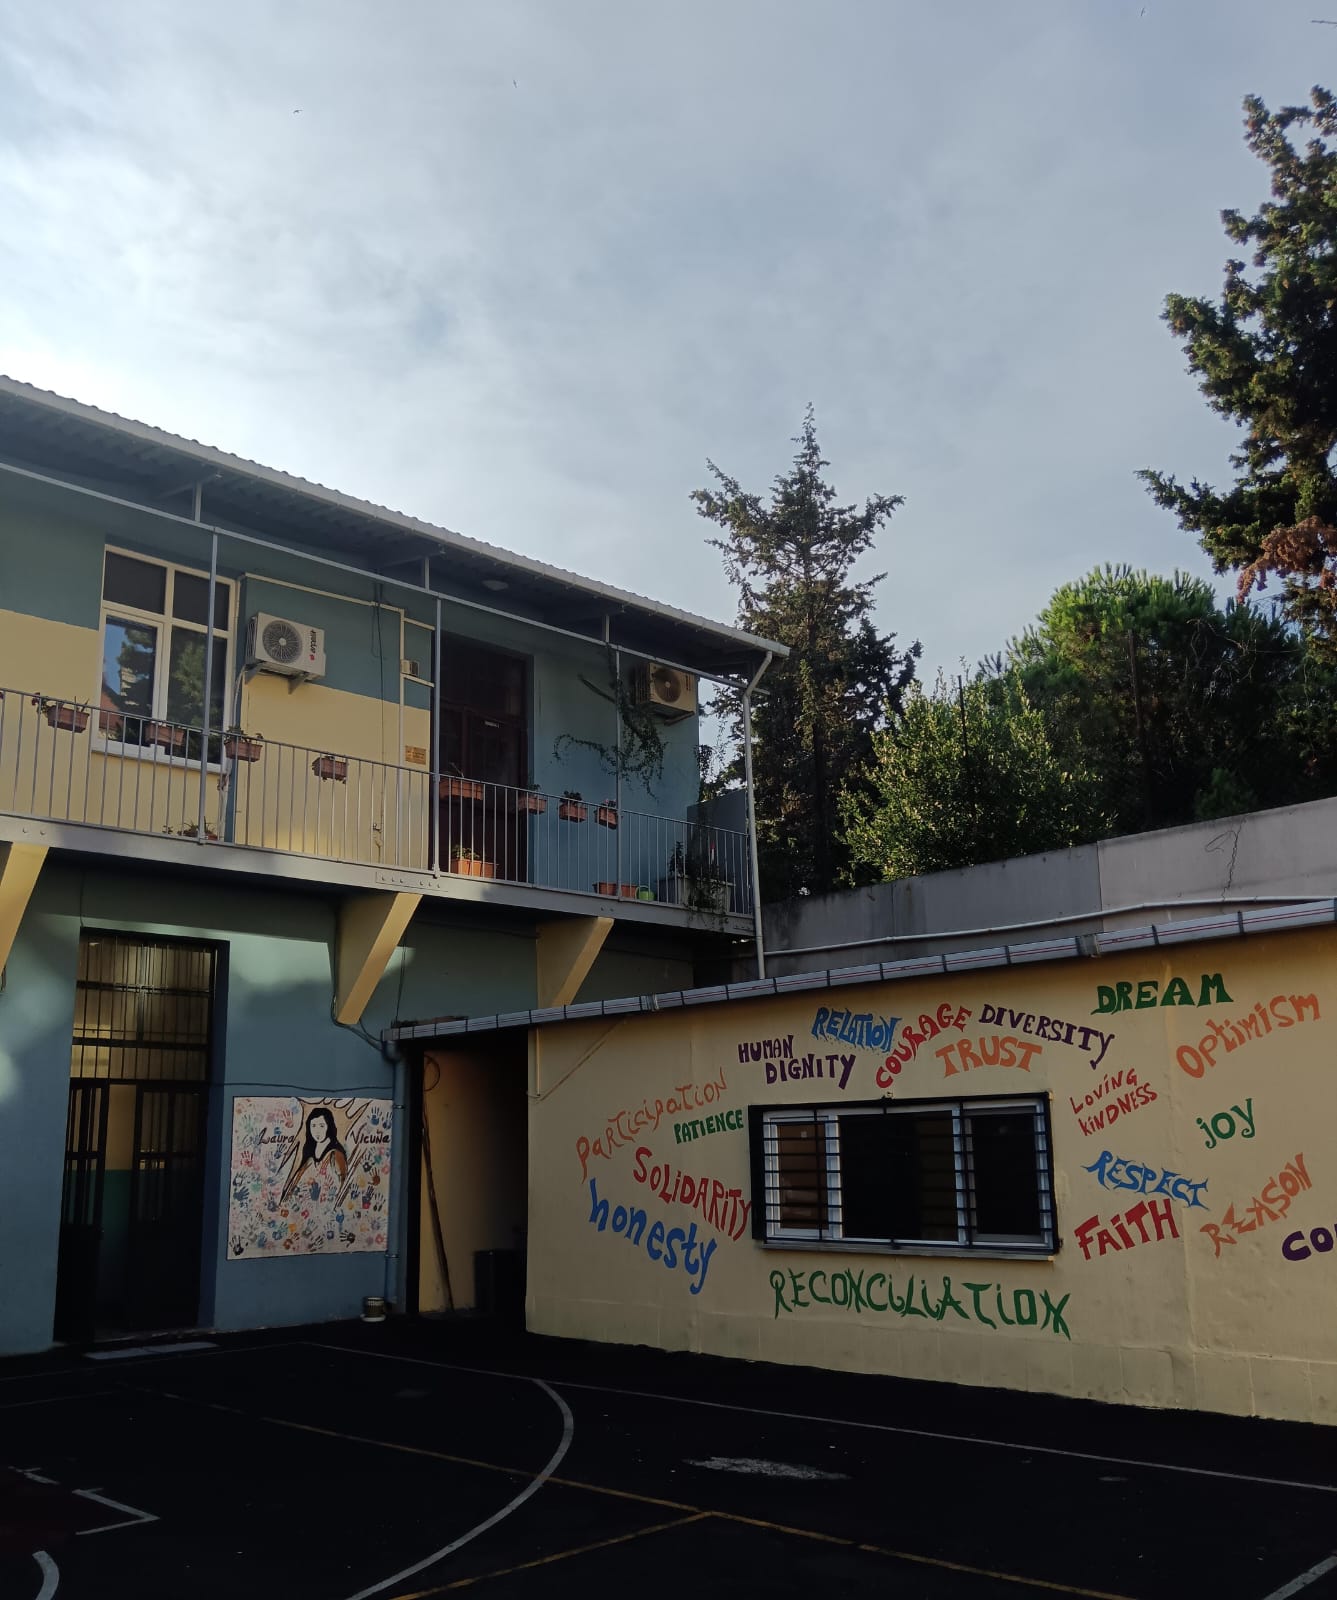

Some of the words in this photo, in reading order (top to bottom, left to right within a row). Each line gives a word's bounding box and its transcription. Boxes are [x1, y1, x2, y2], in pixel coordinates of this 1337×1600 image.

[1091, 973, 1234, 1015] DREAM
[738, 1035, 794, 1063] HUMAN
[875, 1003, 972, 1088] COURAGE
[935, 1036, 1042, 1078] TRUST
[978, 1003, 1115, 1070] DIVERSITY
[765, 1054, 856, 1089] DIGNITY
[257, 1127, 295, 1145] Laura
[674, 1109, 743, 1144] PATIENCE
[1081, 1150, 1209, 1211] RESPECT
[1200, 1152, 1312, 1258] REASON
[589, 1178, 717, 1294] honesty
[1282, 1223, 1337, 1261] CO
